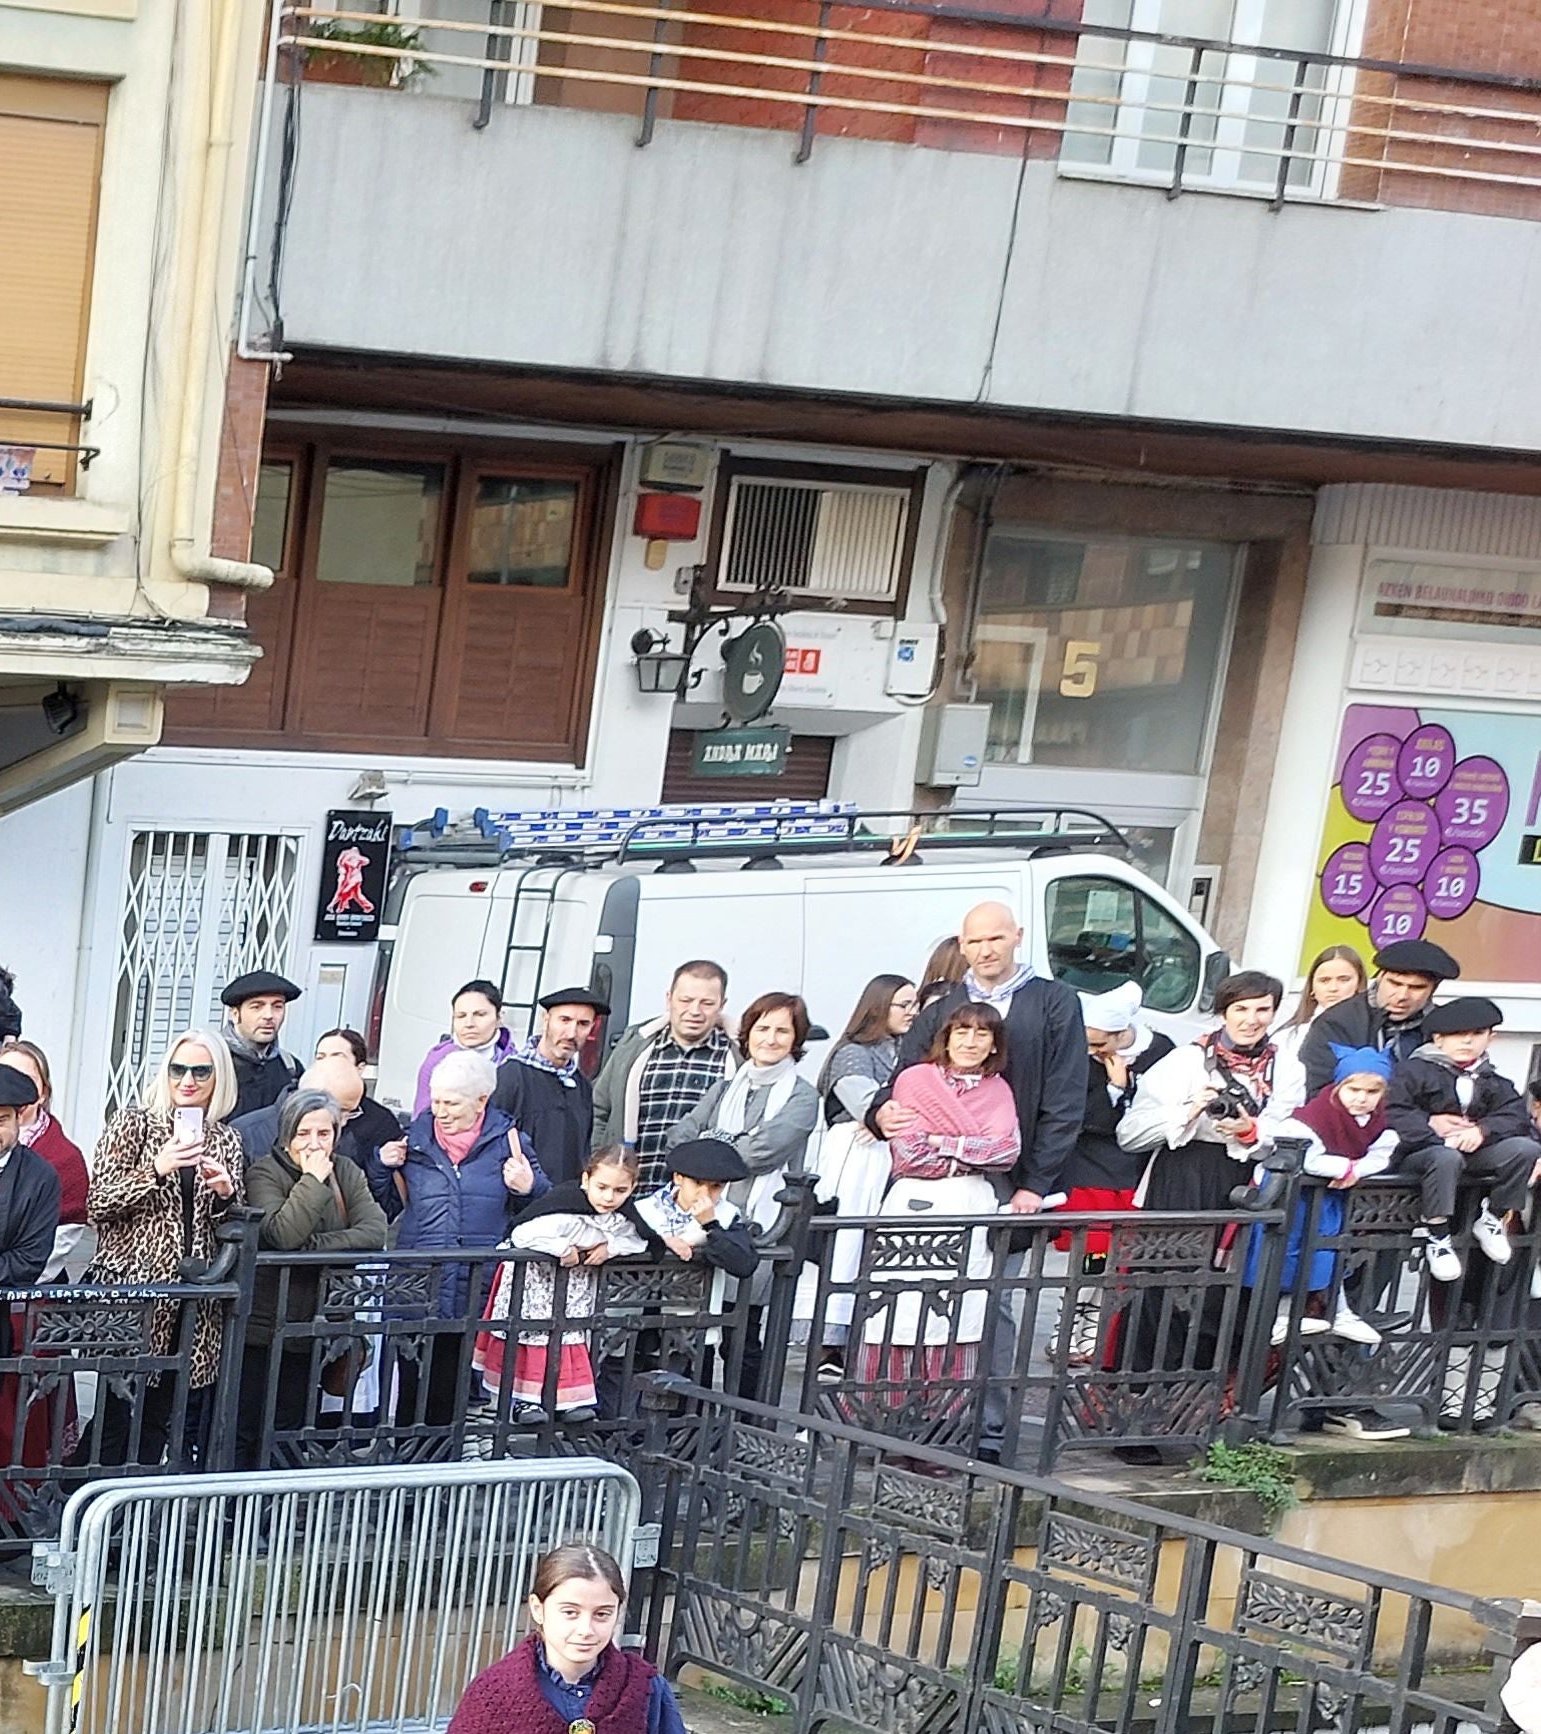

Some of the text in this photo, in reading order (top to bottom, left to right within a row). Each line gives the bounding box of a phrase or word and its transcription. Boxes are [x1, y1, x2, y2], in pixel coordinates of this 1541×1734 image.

[1060, 641, 1102, 698] 5
[1410, 756, 1441, 778] 10
[1357, 771, 1391, 796] 25
[1451, 798, 1489, 825] 35
[1386, 837, 1421, 863] 25
[1333, 874, 1363, 895] 15
[1435, 876, 1466, 898] 10
[1381, 913, 1412, 935] 10
